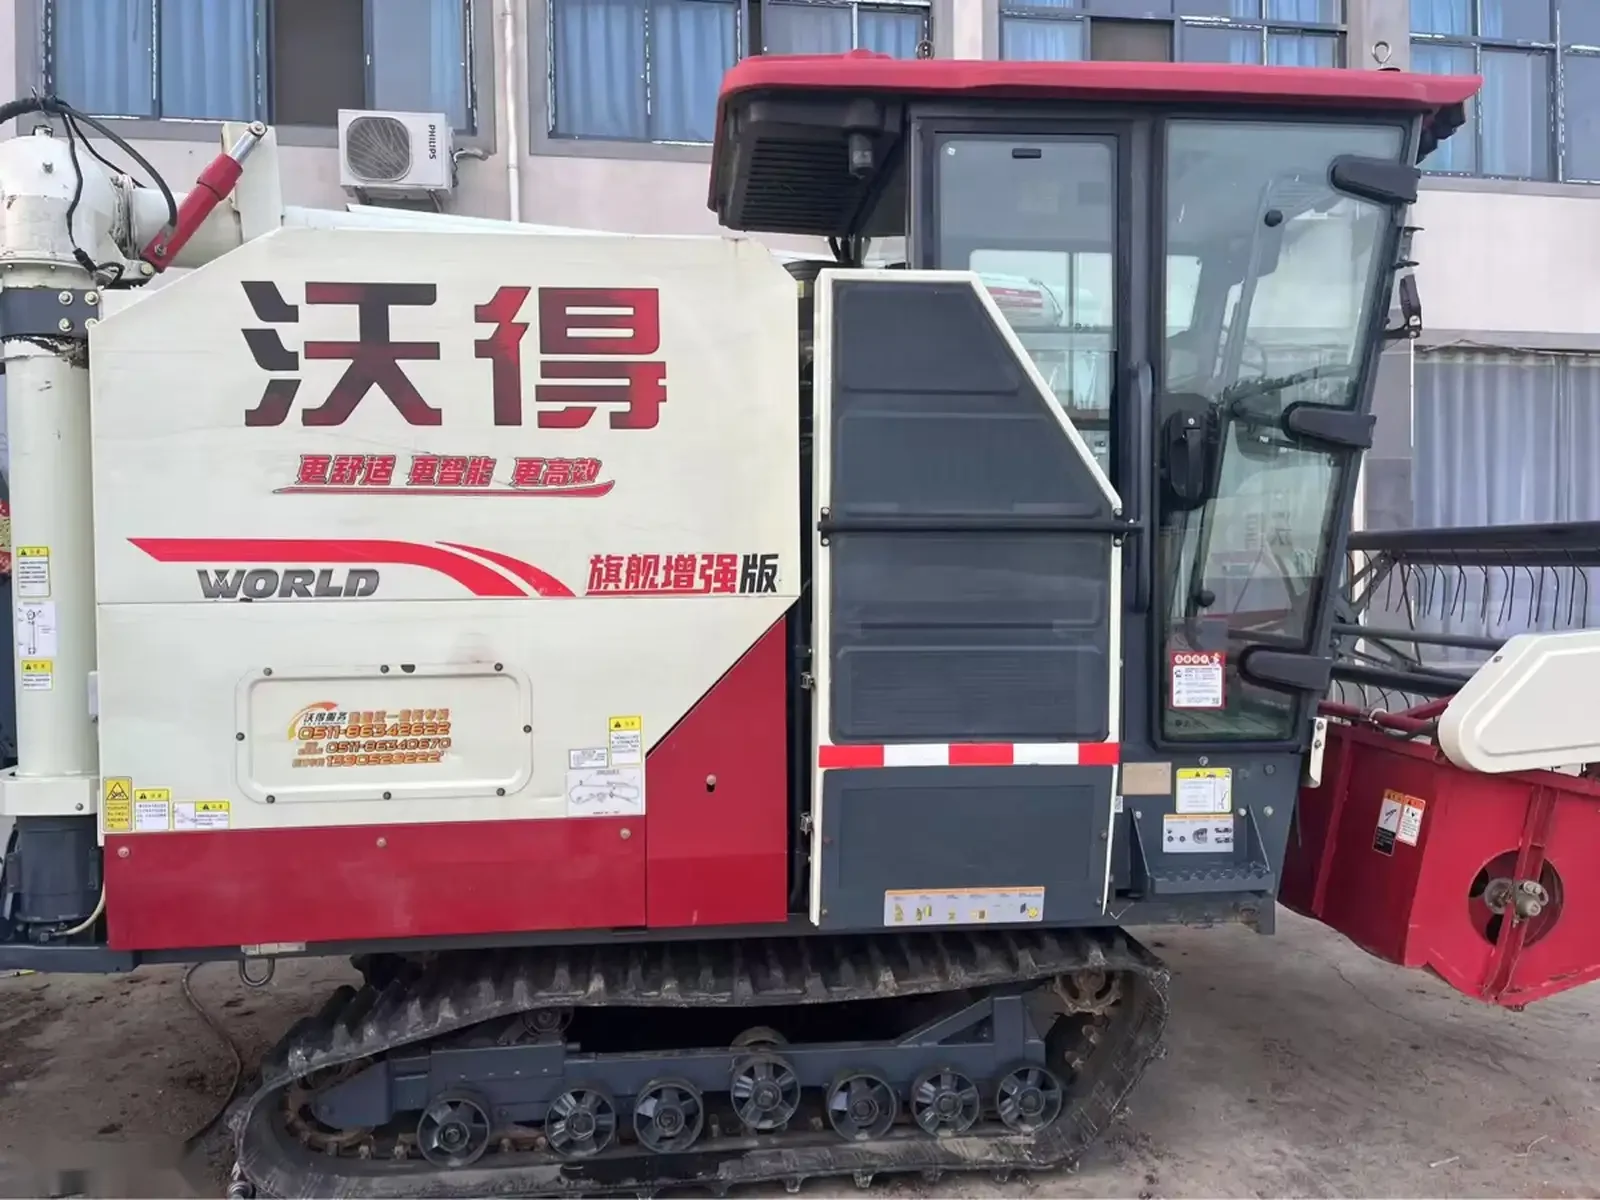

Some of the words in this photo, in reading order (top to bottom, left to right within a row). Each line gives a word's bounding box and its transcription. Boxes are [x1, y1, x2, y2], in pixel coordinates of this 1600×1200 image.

[428, 124, 437, 160] PHILIPS
[240, 280, 667, 430] 沃得
[296, 454, 396, 486] 更舒适
[406, 455, 497, 487] 更智能
[509, 456, 603, 489] 更高效
[196, 568, 380, 599] WORLD
[586, 553, 779, 595] 旗舰增强版
